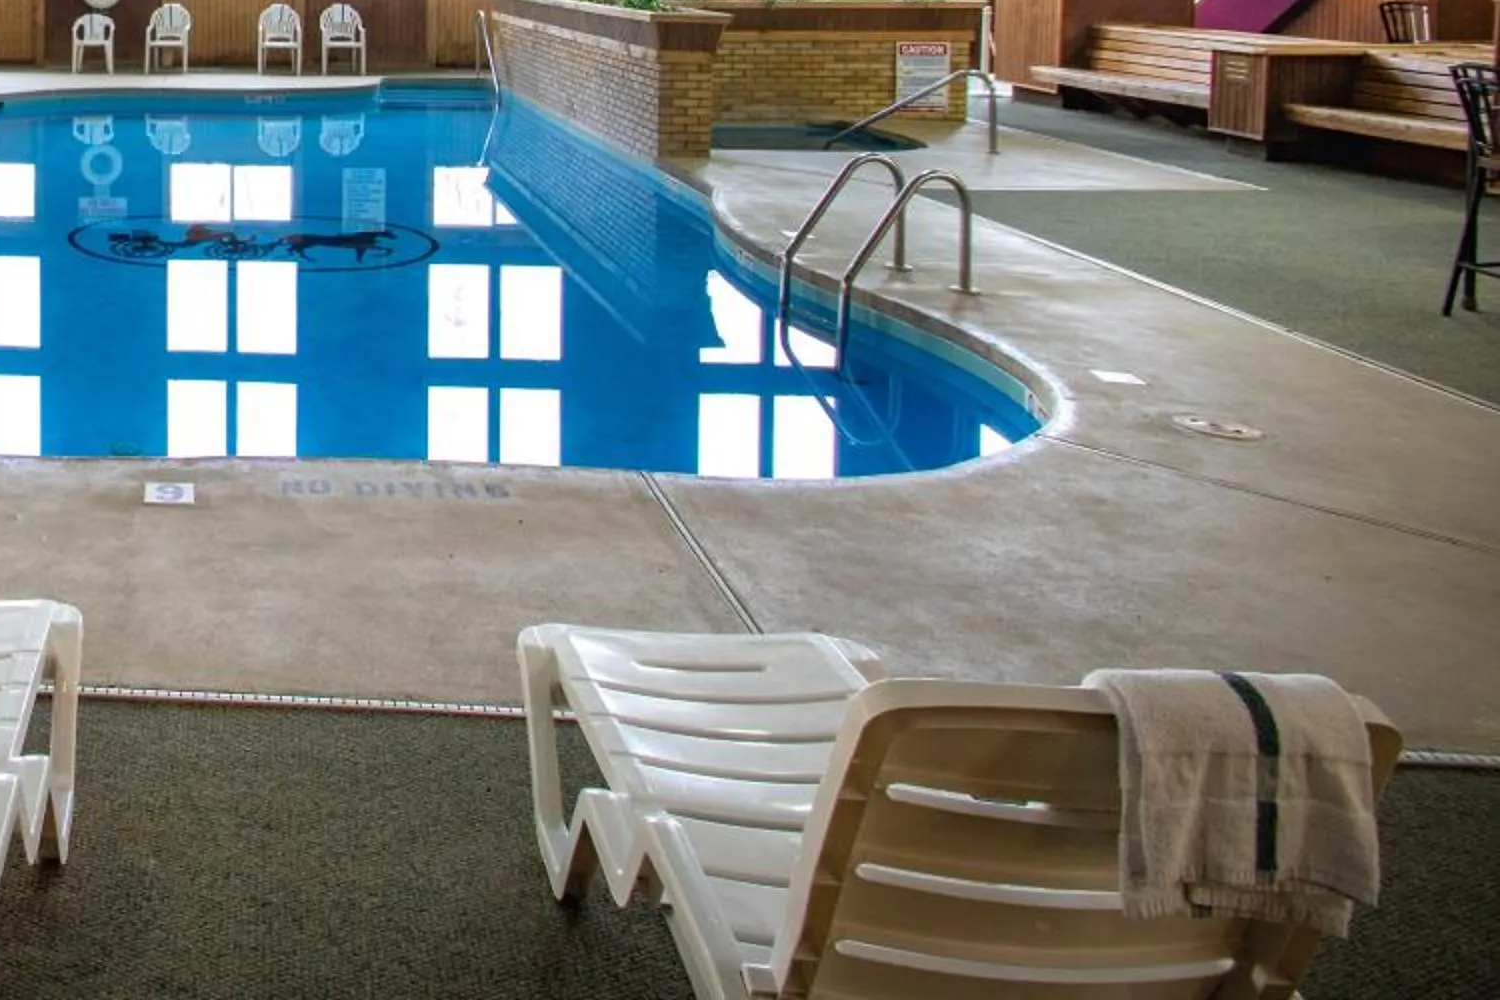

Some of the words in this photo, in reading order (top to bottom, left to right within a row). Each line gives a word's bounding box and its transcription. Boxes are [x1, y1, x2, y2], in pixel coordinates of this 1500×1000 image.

[902, 44, 944, 55] CAUTION
[155, 483, 185, 502] 9
[280, 479, 332, 495] NO
[354, 480, 511, 500] DIVING
